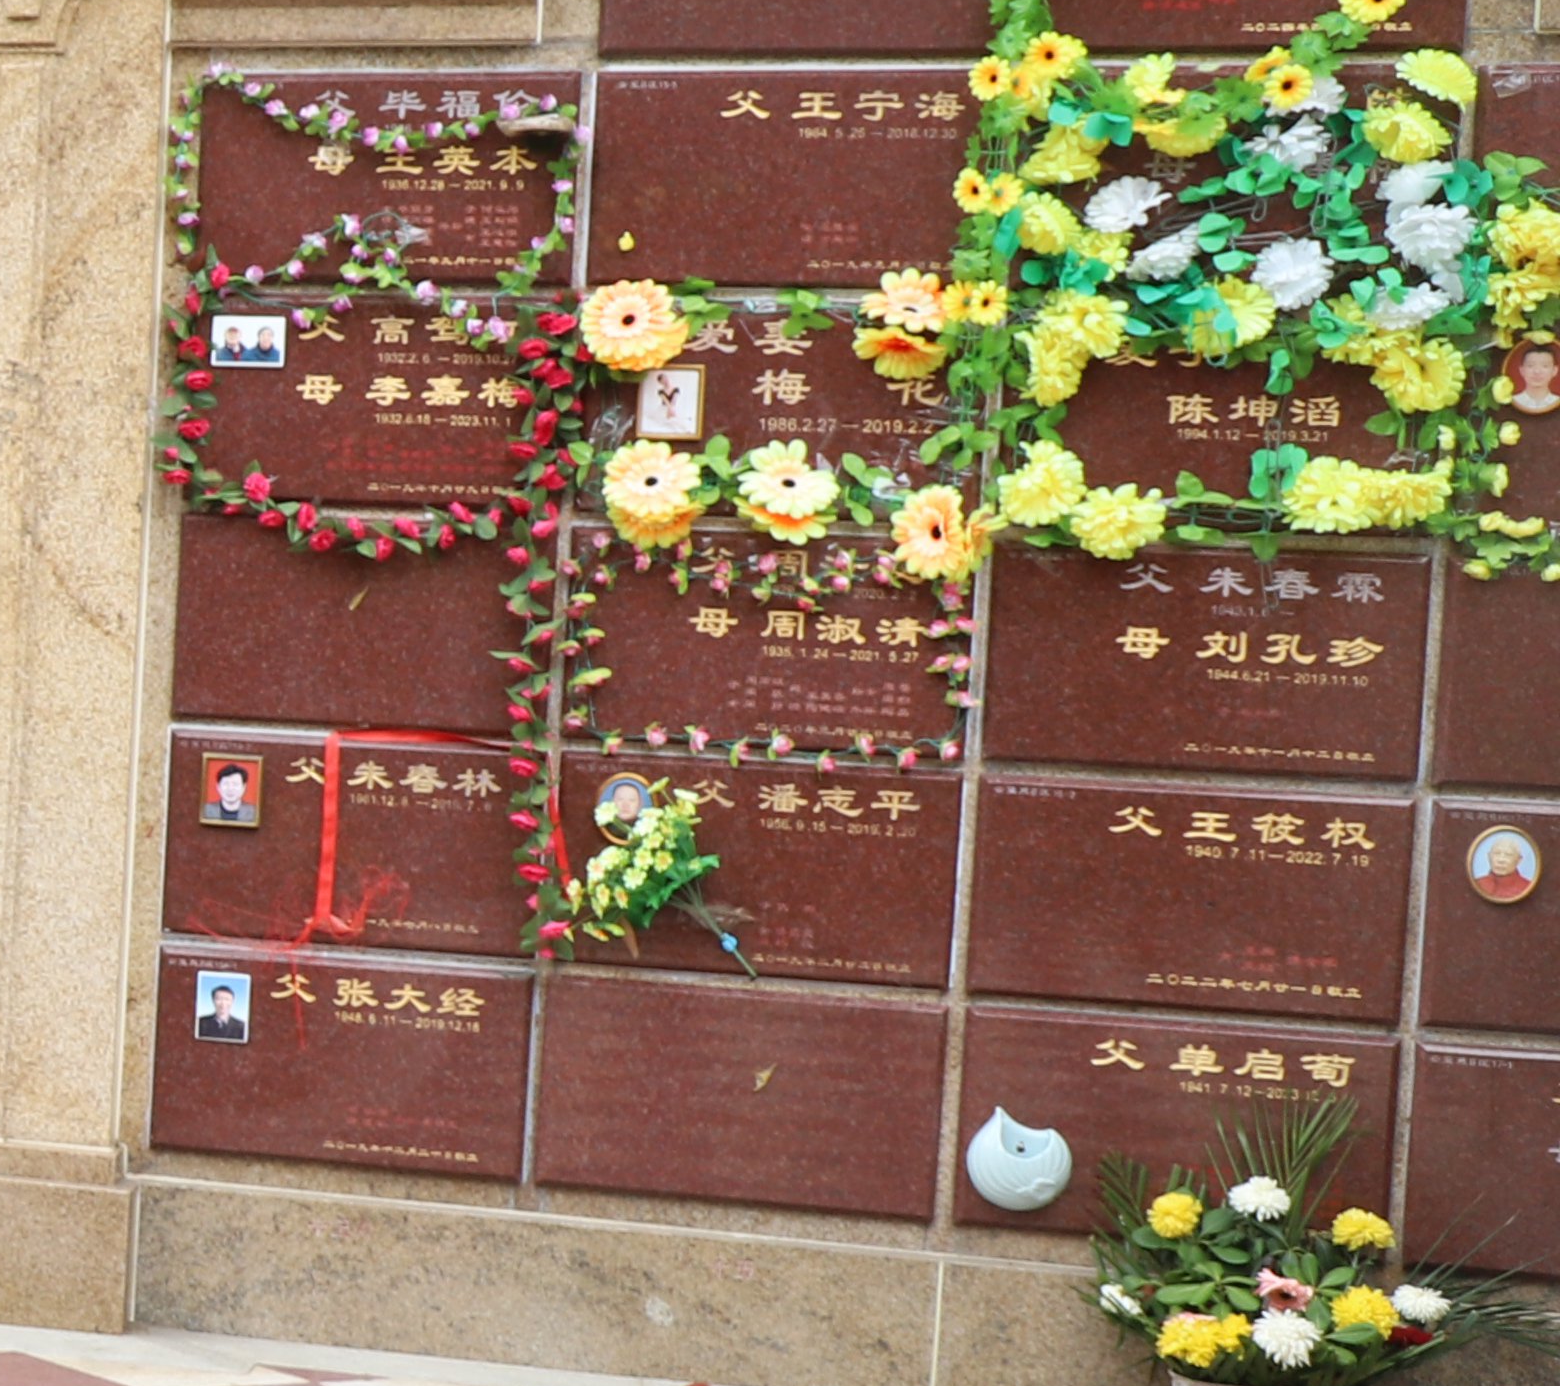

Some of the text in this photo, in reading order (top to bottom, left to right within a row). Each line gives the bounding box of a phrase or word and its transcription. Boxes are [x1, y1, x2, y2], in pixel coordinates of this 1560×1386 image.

[721, 90, 965, 121] 父 王宁海
[296, 374, 518, 409] 母 李嘉梅
[752, 368, 811, 406] 梅
[1120, 563, 1174, 594] 父
[689, 606, 928, 647] 母 周淑清
[1116, 626, 1384, 668] 母 刘孔珍
[347, 759, 503, 799] 朱春林
[758, 784, 921, 821] 潘志平
[1108, 805, 1162, 837] 父
[270, 972, 485, 1017] 父 张大经
[1090, 1037, 1145, 1071] 父
